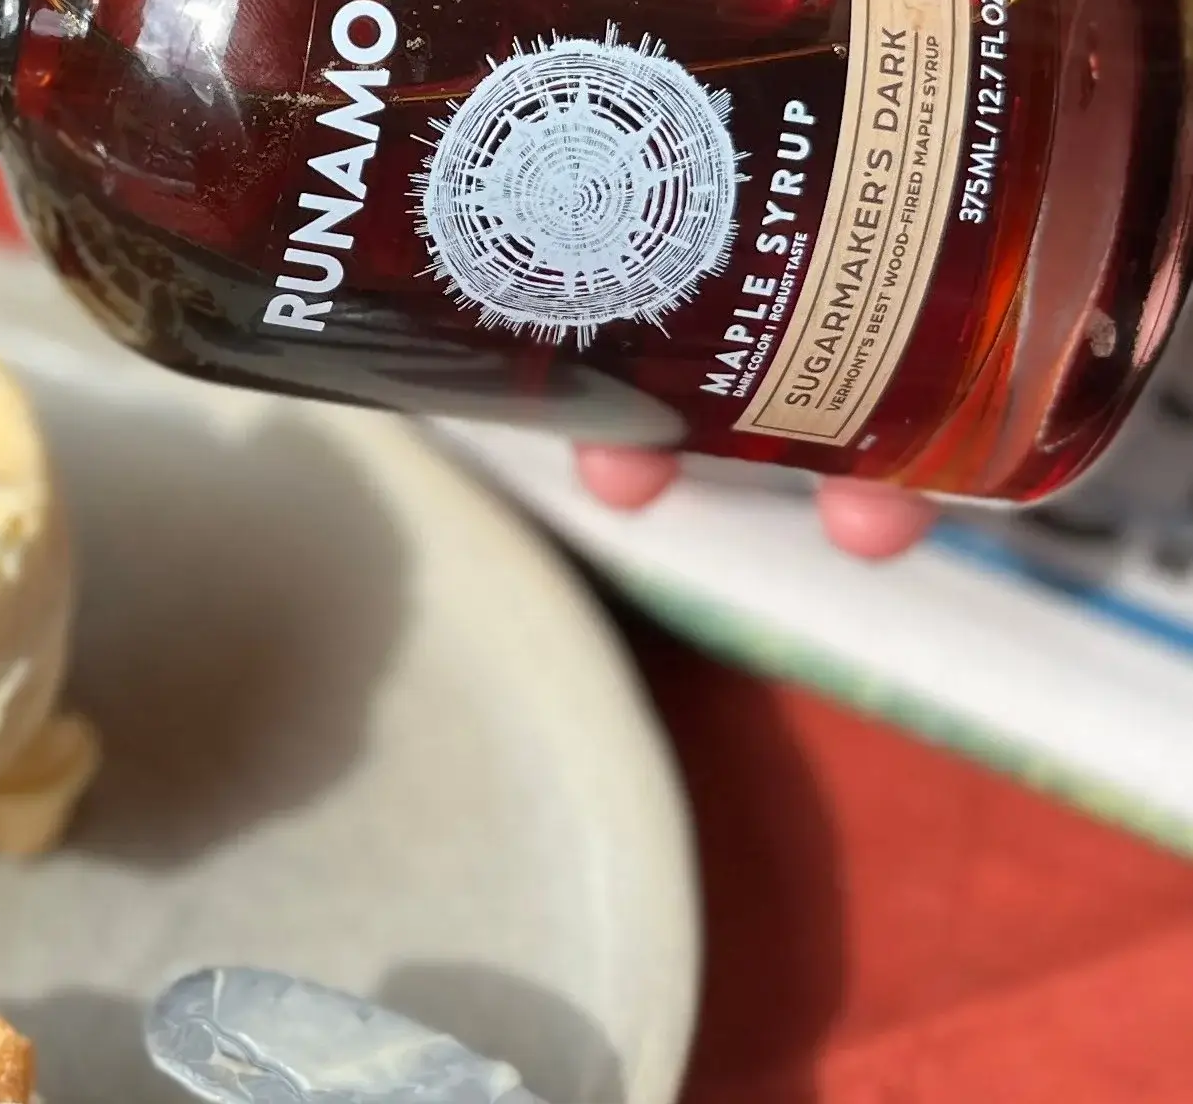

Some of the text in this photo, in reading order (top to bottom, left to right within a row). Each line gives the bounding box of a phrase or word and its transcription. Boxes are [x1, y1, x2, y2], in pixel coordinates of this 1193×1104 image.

[923, 35, 940, 96] SYRUP
[977, 64, 1008, 115] 12.7
[912, 101, 935, 166] MAPLE
[784, 27, 907, 407] SUGARMAKER'S DARK
[959, 137, 997, 224] 375ML
[699, 100, 816, 396] MAPLE SYRUP
[882, 171, 923, 288] WOOD-FIRED
[732, 371, 756, 397] DARK
[748, 333, 774, 371] COLOR
[768, 272, 796, 321] ROBUST
[786, 232, 808, 271] TASTE
[866, 292, 892, 334] BEST
[825, 337, 875, 411] VERMONT'S
